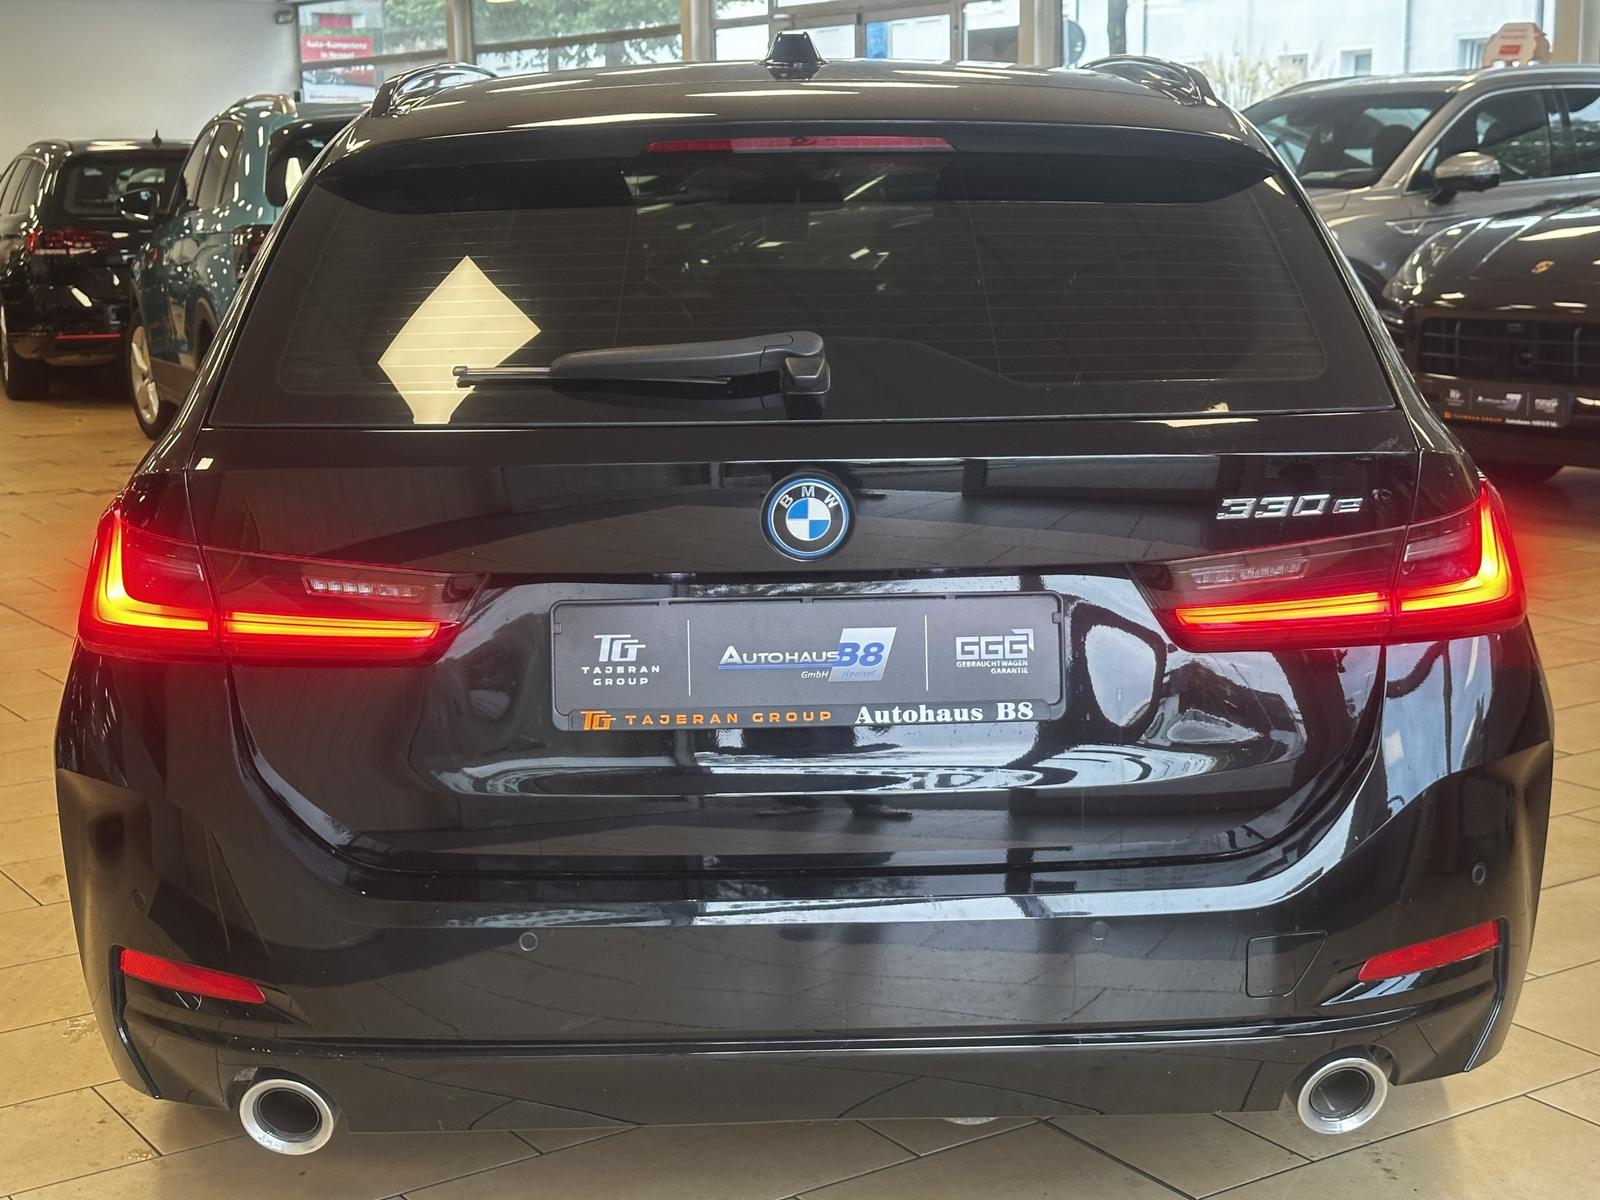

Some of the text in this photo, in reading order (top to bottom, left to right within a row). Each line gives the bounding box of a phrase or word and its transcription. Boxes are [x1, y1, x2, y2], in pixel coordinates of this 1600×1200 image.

[779, 485, 839, 509] BMW
[955, 635, 1028, 661] GGG
[719, 642, 886, 668] AUTOHAUS B8
[581, 665, 660, 674] TAJERAN
[956, 659, 1028, 668] GEBRAUCHTWAGEN
[800, 670, 829, 680] GmbH
[990, 667, 1029, 675] GARANTIE
[593, 677, 649, 686] GROUP
[624, 712, 738, 725] TAJERAN
[751, 711, 832, 723] GROUP
[854, 701, 1034, 725] Autohaus B8
